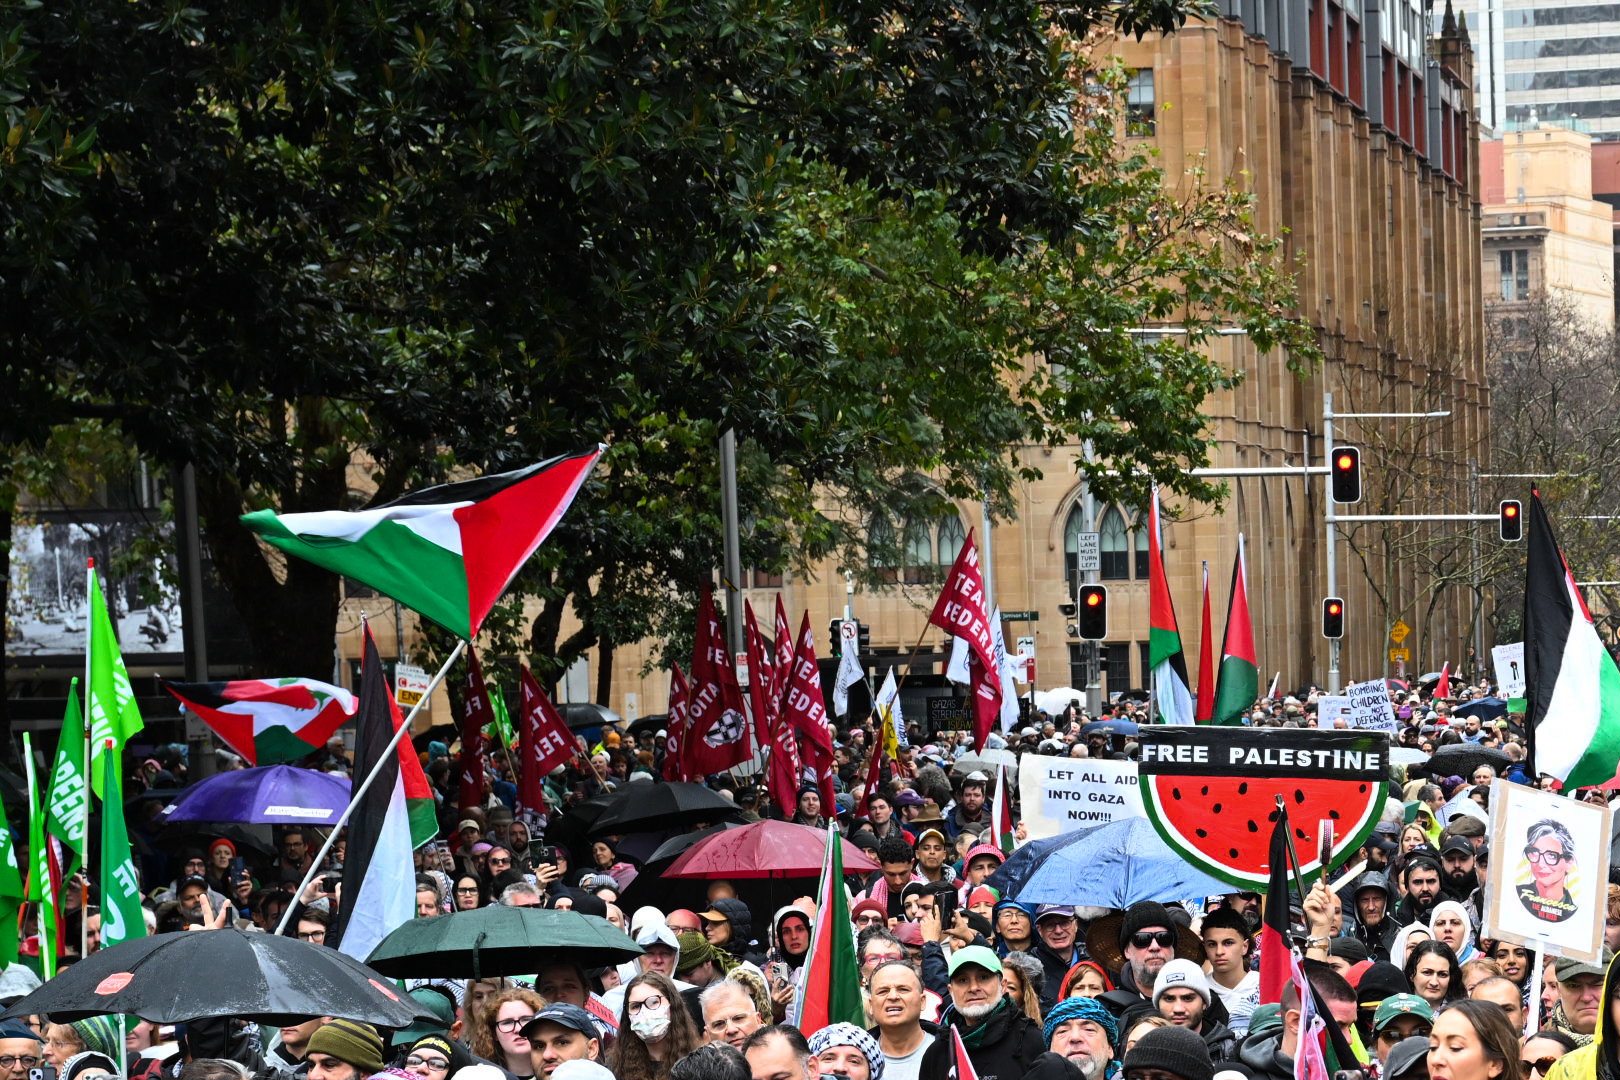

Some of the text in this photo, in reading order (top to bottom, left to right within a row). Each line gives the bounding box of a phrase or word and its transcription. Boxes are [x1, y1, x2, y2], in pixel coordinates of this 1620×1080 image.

[1348, 683, 1385, 697] BOMBING
[1350, 694, 1389, 709] CHILDREN
[1371, 705, 1385, 714] NOT
[932, 720, 941, 729] IN
[1355, 713, 1391, 726] DEFENCE
[1142, 743, 1381, 771] FREE PALESTINE
[1048, 769, 1138, 787] LET ALL AID
[50, 750, 84, 841] REENS
[1047, 788, 1126, 806] INTO GAZA
[1067, 809, 1112, 823] NOW!!!
